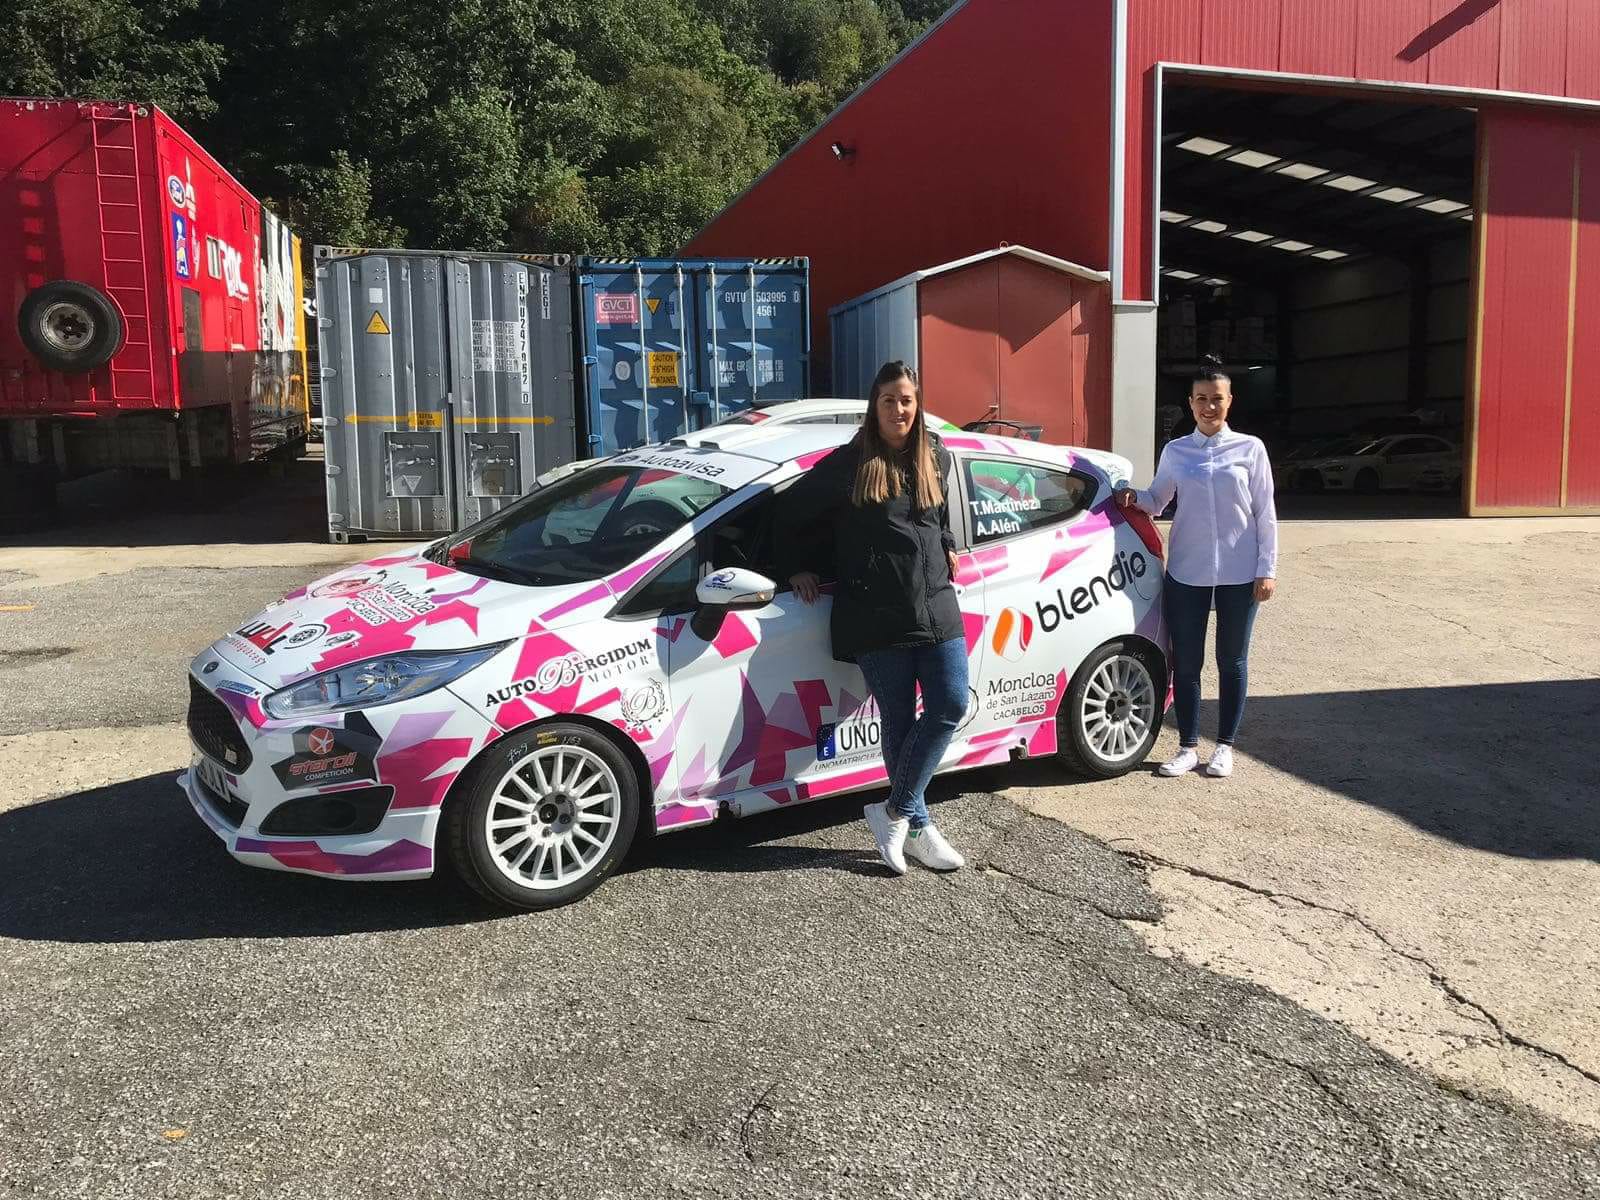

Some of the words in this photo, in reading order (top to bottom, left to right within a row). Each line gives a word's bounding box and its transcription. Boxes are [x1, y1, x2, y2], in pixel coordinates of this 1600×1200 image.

[601, 299, 631, 310] GVCT
[725, 291, 746, 303] GVTU
[976, 517, 1021, 537] A.Alén
[1035, 550, 1147, 633] blendio
[588, 655, 650, 684] MOTOR
[485, 679, 538, 708] AUTO
[986, 672, 1056, 697] Moncloa
[986, 699, 998, 710] de
[1000, 695, 1018, 706] San
[993, 704, 1045, 721] CACABELOS
[840, 721, 880, 751] UNO
[823, 746, 830, 757] E
